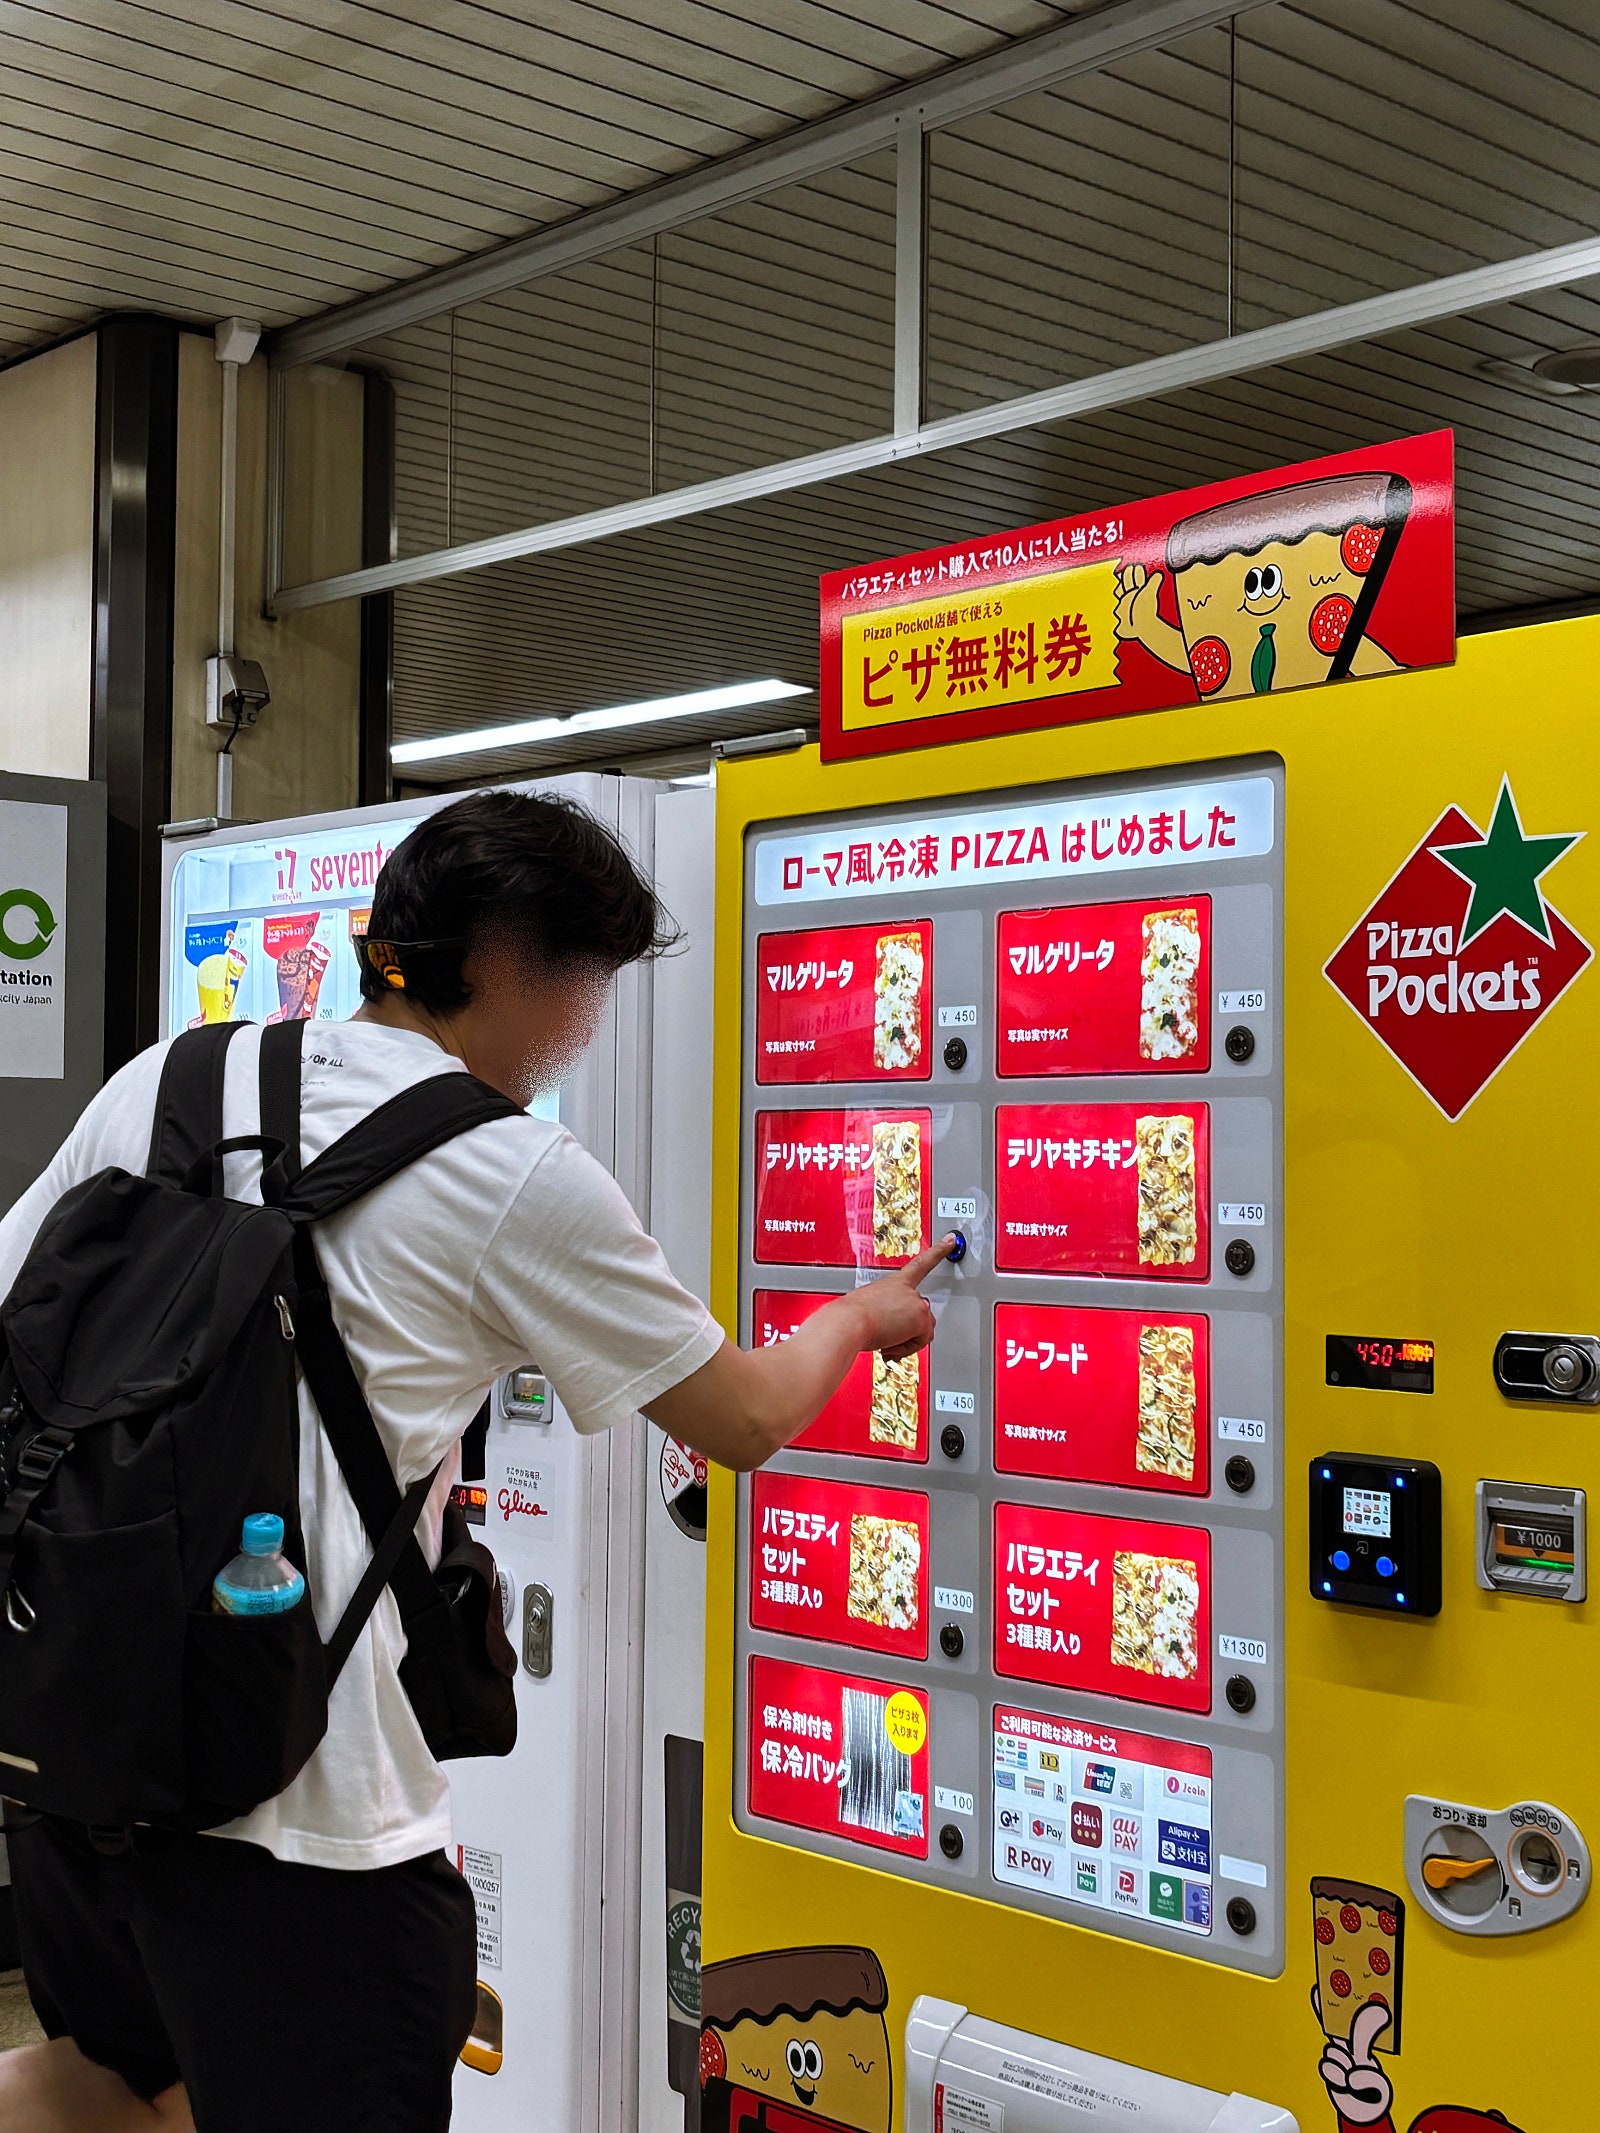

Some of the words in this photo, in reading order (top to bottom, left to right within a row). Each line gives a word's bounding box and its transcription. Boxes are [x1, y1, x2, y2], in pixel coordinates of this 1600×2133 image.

[841, 520, 1124, 600] バラエティセット購入で10人に1人当たる!
[863, 618, 892, 642] Pizza
[895, 600, 1003, 636] Pocket店舗で使える
[863, 613, 1093, 710] ピザ無料券
[783, 834, 940, 891] ローマ風冷凍
[951, 826, 1050, 872] PIZZA
[1060, 804, 1238, 864] はじめました
[1366, 921, 1453, 961] Pizza
[1007, 938, 1115, 976] マルゲリータ
[765, 958, 855, 993] マルゲリータ
[1366, 960, 1541, 1017] Pockets
[23, 994, 52, 1005] Japan
[1238, 993, 1263, 1009] 450
[954, 1008, 976, 1024] 450
[1007, 1027, 1069, 1043] 写真は実寸サイズ
[765, 1038, 816, 1054] 写真は実寸サイズ
[328, 1058, 344, 1068] ALL
[765, 1141, 876, 1173] テリヤキチキン
[1006, 1137, 1141, 1172] テリヤキチキン
[954, 1200, 975, 1215] 450
[1238, 1205, 1263, 1221] 450
[764, 1218, 816, 1233] 写真は実寸サイズ
[1005, 1221, 1068, 1237] 写真は実寸サイズ
[1005, 1338, 1089, 1375] シーフード
[1356, 1342, 1393, 1367] 450
[952, 1394, 974, 1410] 450
[1004, 1423, 1067, 1443] 写真は実寸サイズ
[1238, 1421, 1263, 1438] 450
[498, 1488, 548, 1521] Glico
[762, 1506, 840, 1547] バラエティ
[761, 1543, 807, 1578] セット
[1006, 1542, 1101, 1587] バラエティ
[761, 1579, 823, 1609] 3種類入り
[938, 1589, 973, 1609] ¥1300
[1006, 1583, 1060, 1620] セット
[1006, 1622, 1081, 1657] 3種類入り
[1223, 1638, 1264, 1659] ¥1300
[763, 1705, 833, 1741] 保冷剤付き
[891, 1706, 920, 1724] ピザ3枚
[892, 1723, 919, 1742] 入ります
[1001, 1715, 1118, 1755] ご利用可能な決済サービス
[952, 1794, 973, 1811] 100
[1073, 1811, 1100, 1830] d払い
[1113, 1818, 1140, 1835] au
[1432, 1806, 1487, 1829] おつり・返却
[1046, 1824, 1063, 1841] Pay
[1114, 1834, 1139, 1852] PAY
[1021, 1850, 1052, 1878] Pay
[1177, 1847, 1208, 1867] 支付宝
[1077, 1861, 1097, 1875] LINE
[1079, 1876, 1095, 1889] Pay
[1114, 1890, 1139, 1906] PayPay
[667, 1906, 702, 1939] RECY
